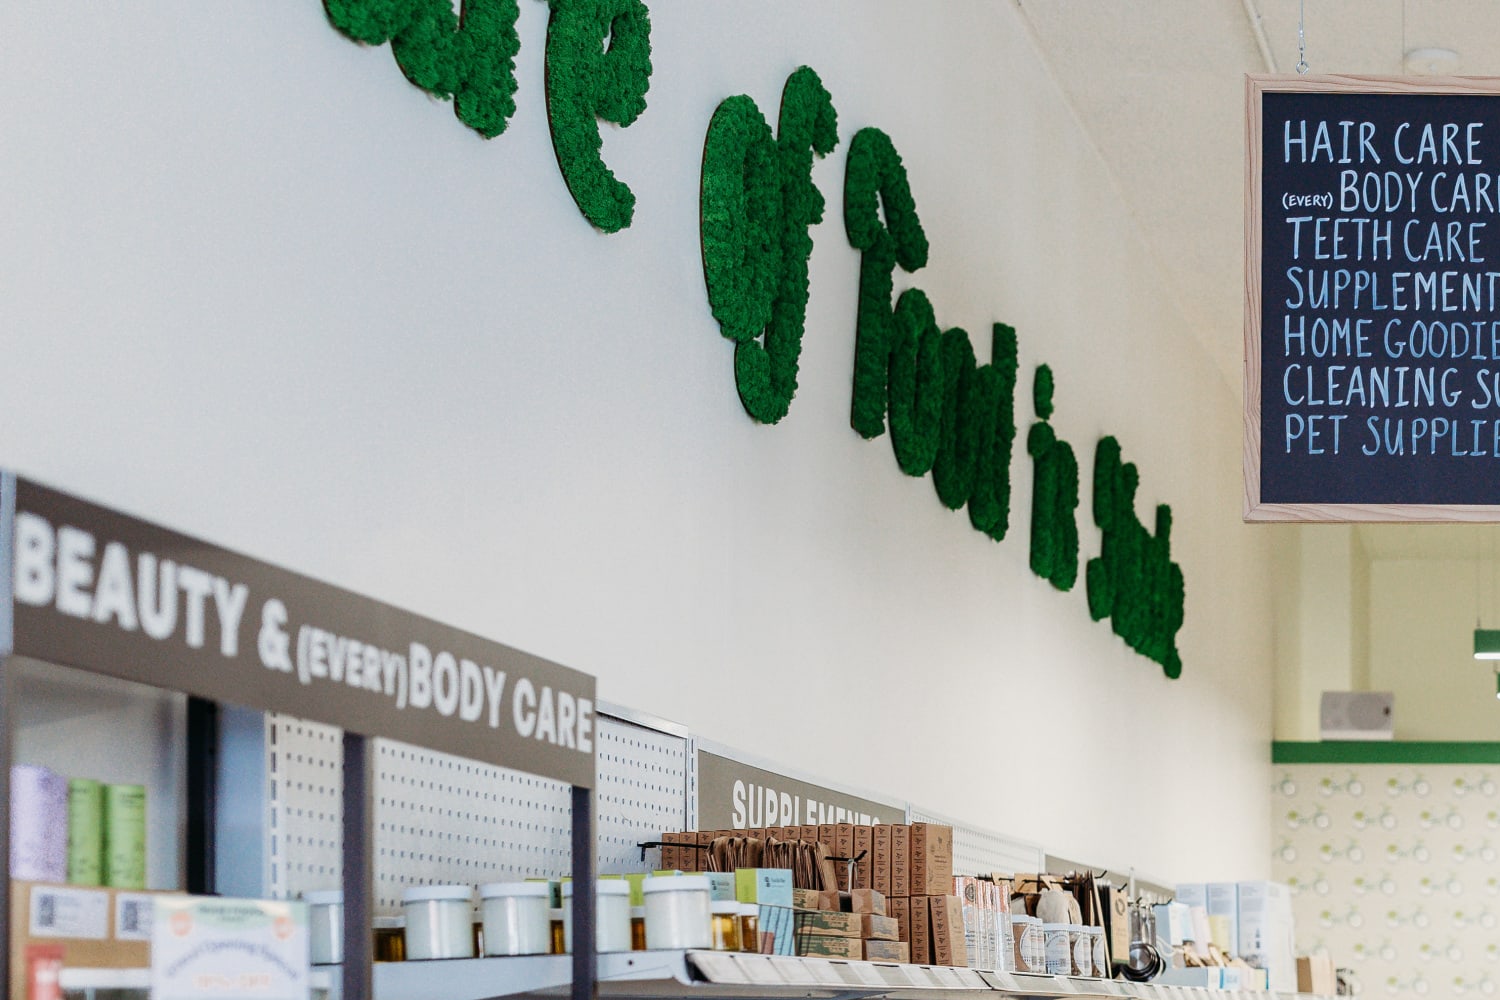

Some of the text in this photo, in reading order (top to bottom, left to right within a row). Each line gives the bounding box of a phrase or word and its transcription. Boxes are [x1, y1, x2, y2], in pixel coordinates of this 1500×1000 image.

[1284, 120, 1484, 165] HAIR CARE
[1285, 216, 1486, 263] TEETH CARE
[1284, 315, 1372, 358] HOME
[1283, 363, 1462, 408] CLEANING
[1285, 413, 1348, 456] PET
[14, 511, 249, 658] BEAUTY
[257, 598, 292, 675] &
[512, 677, 594, 755] CARE
